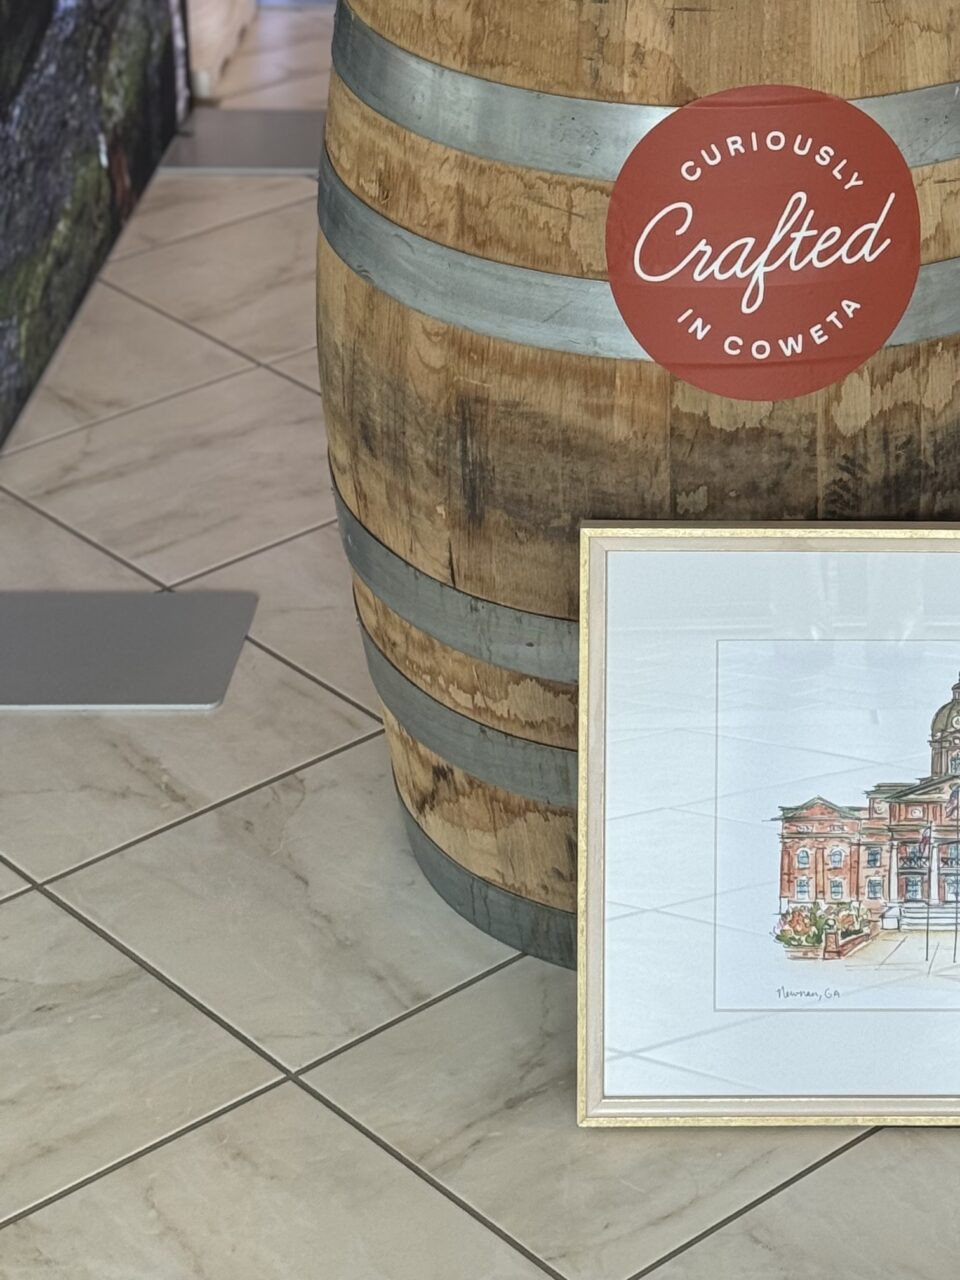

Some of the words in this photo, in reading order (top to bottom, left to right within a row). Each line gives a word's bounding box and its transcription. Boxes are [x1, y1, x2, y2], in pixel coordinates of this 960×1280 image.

[680, 130, 864, 191] CURIOUSLY
[633, 191, 896, 315] Crafted
[677, 308, 712, 341] IN
[723, 299, 861, 361] COWETA
[824, 987, 841, 999] GA
